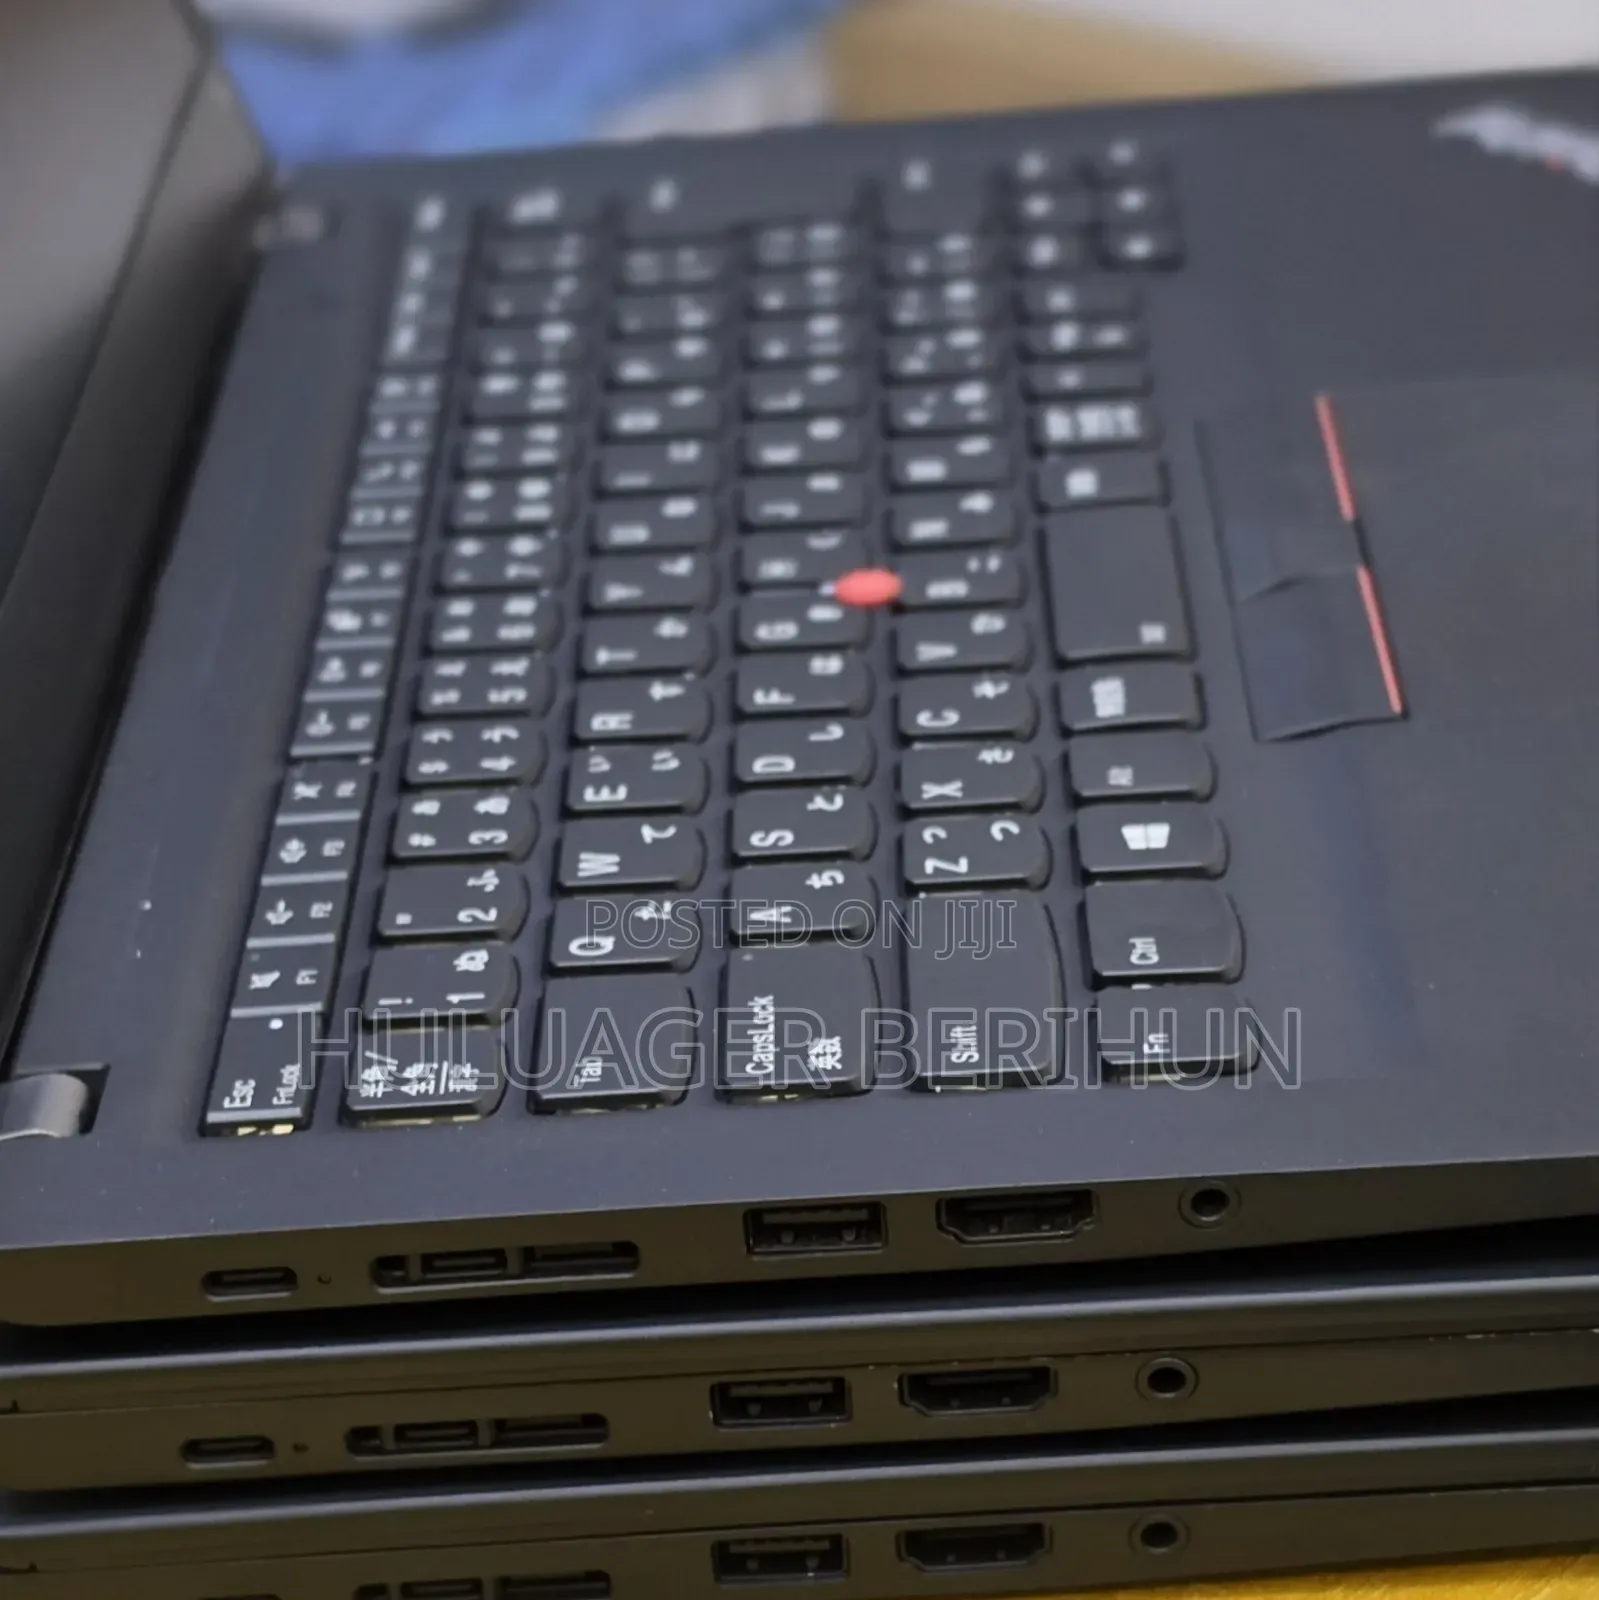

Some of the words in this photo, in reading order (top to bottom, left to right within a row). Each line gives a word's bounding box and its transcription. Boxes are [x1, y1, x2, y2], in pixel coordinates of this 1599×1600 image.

[596, 647, 638, 664] T
[487, 687, 527, 704] 5
[753, 687, 795, 707] F
[590, 711, 634, 731] R
[916, 709, 960, 728] C
[808, 724, 844, 742] し
[480, 756, 517, 771] 4
[651, 749, 681, 771] い
[751, 755, 795, 774] D
[583, 784, 628, 803] E
[921, 780, 964, 799] X
[468, 829, 509, 846] 3
[640, 824, 677, 844] て
[748, 829, 794, 848] S
[577, 852, 621, 877] W
[925, 855, 968, 875] Z
[466, 869, 500, 892] ふ
[805, 868, 845, 890] ち
[310, 900, 333, 918] F2
[457, 906, 498, 923] 2
[748, 905, 792, 924] A
[568, 936, 615, 957] Q
[1129, 937, 1159, 966] Ctrl
[296, 969, 319, 985] F1
[446, 991, 486, 1003] 1
[745, 995, 776, 1076] CapsLock
[951, 1023, 980, 1064] Shift
[1143, 1032, 1171, 1055] Fn
[573, 1056, 604, 1087] Tab
[223, 1078, 256, 1110] Esc
